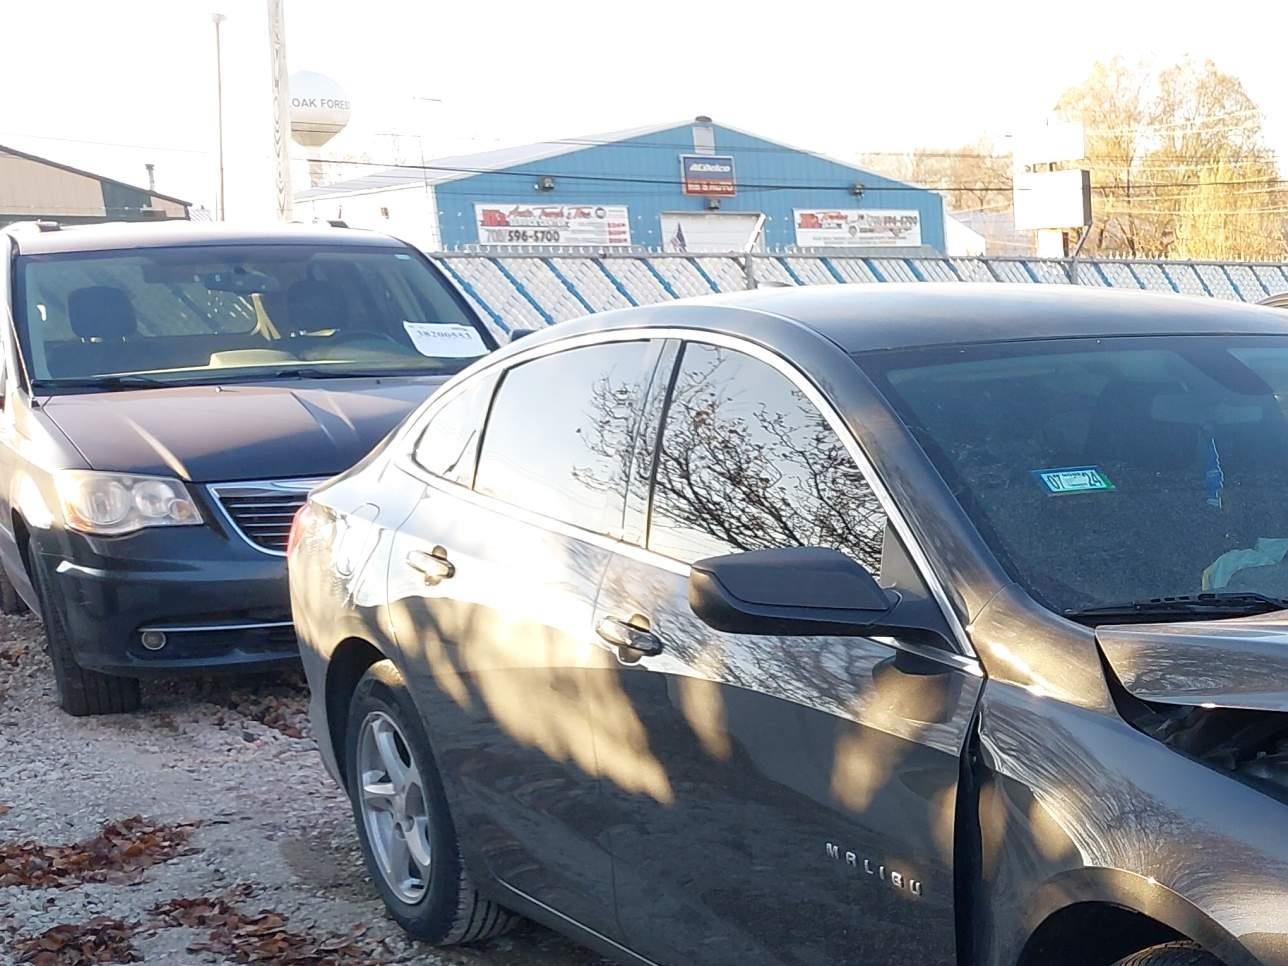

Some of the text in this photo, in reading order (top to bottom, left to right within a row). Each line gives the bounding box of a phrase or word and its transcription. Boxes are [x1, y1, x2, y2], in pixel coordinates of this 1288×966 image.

[291, 97, 318, 108] OAK
[508, 230, 560, 242] 596-5700
[1047, 471, 1102, 489] 07 24
[826, 843, 921, 895] MALIBU
